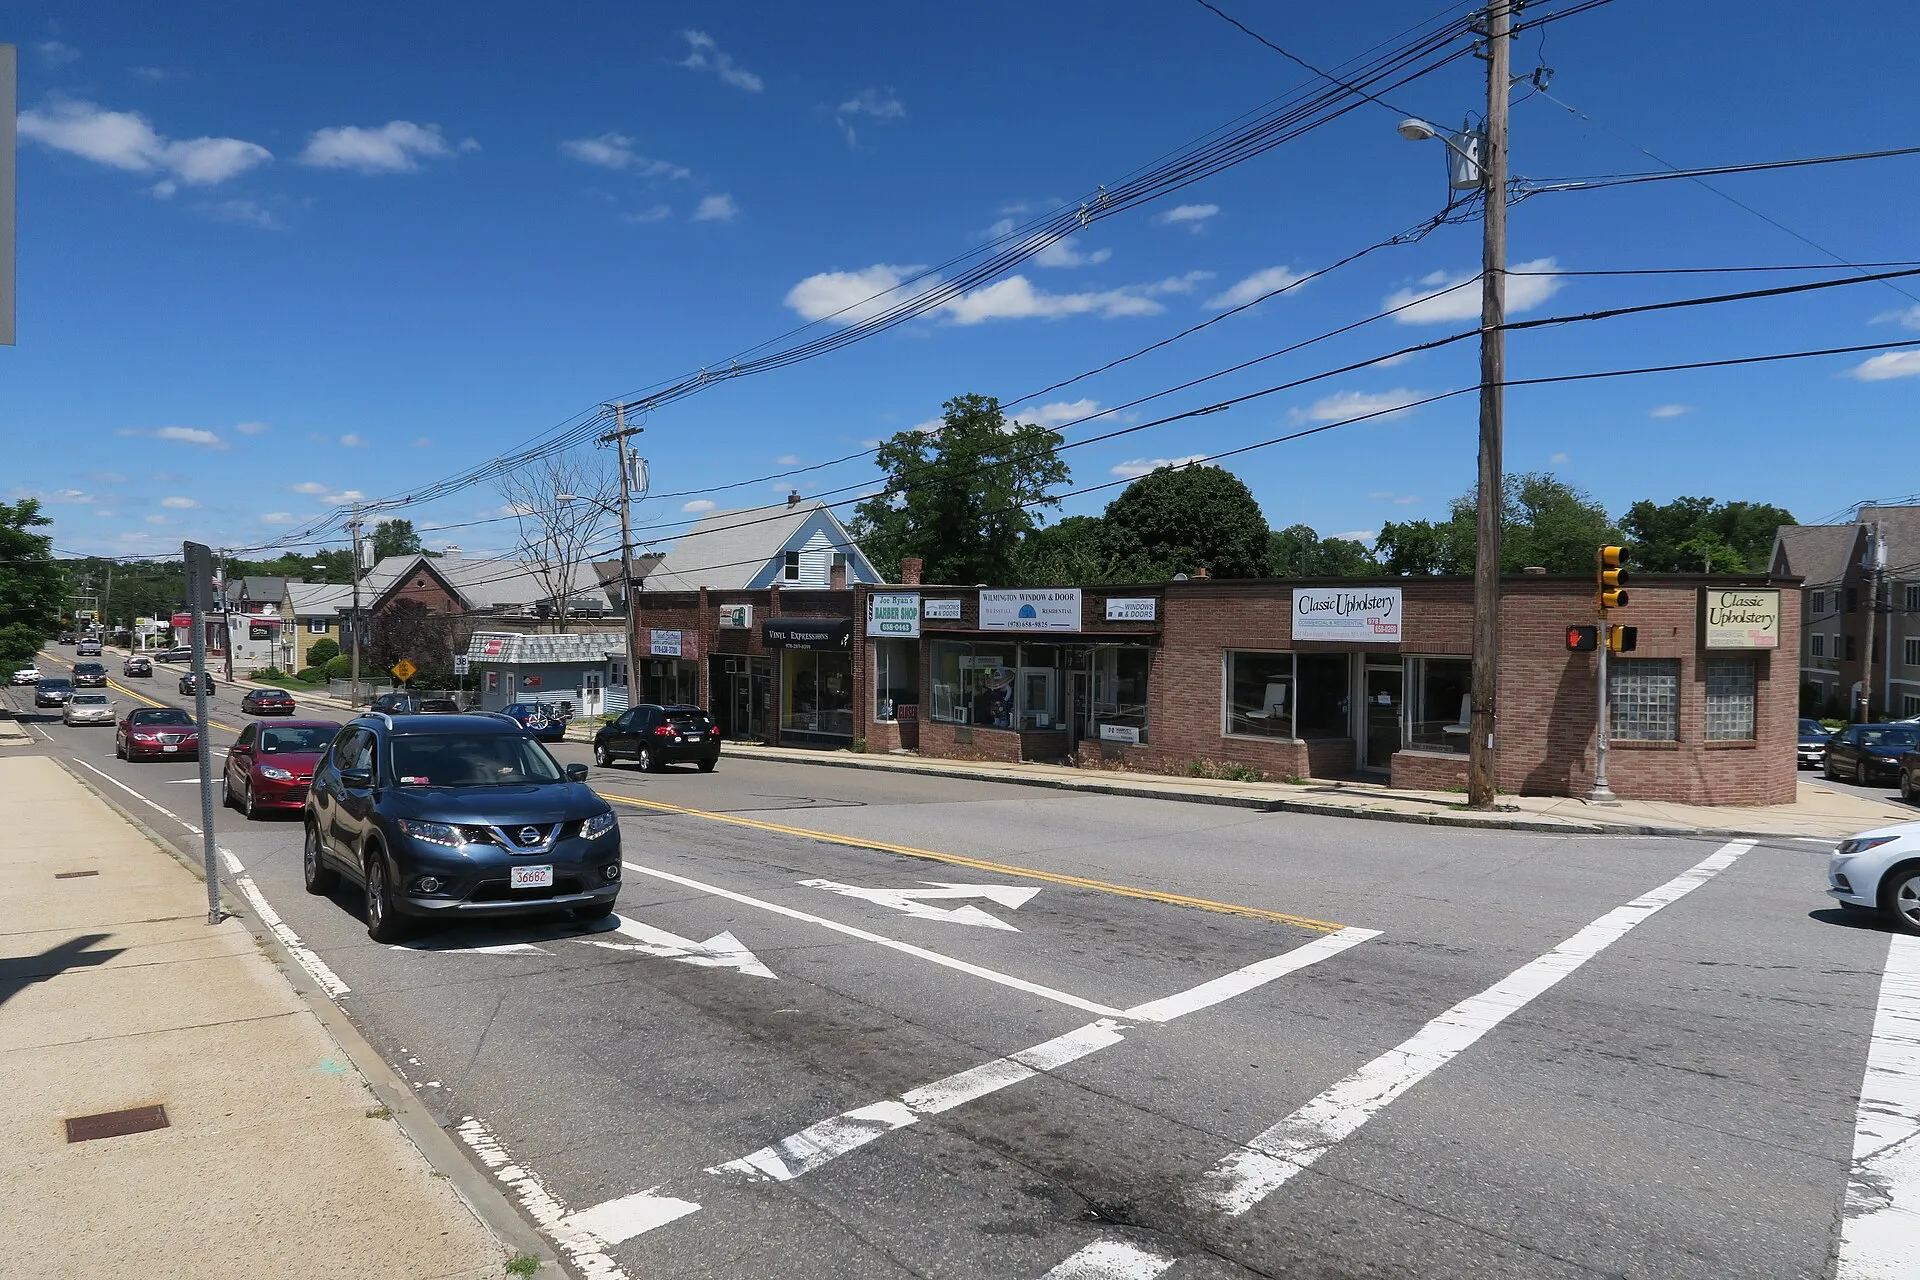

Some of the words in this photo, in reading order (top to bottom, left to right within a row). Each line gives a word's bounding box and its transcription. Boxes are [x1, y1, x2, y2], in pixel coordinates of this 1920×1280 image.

[892, 596, 913, 605] Ryan's
[1019, 593, 1047, 602] WINDOW
[1048, 593, 1053, 601] &
[1054, 593, 1075, 601] DOOR
[1720, 591, 1765, 609] Classic
[1298, 595, 1336, 615] Classic
[1336, 593, 1395, 618] Upholstery
[875, 607, 899, 620] BARBER
[900, 607, 918, 620] SHOP
[1130, 610, 1153, 618] DOORS
[1709, 607, 1776, 631] Upholstery
[768, 630, 787, 640] VINYL
[790, 631, 829, 640] EXPRESSIONS
[456, 657, 467, 666] 38
[898, 705, 918, 719] CLOSED
